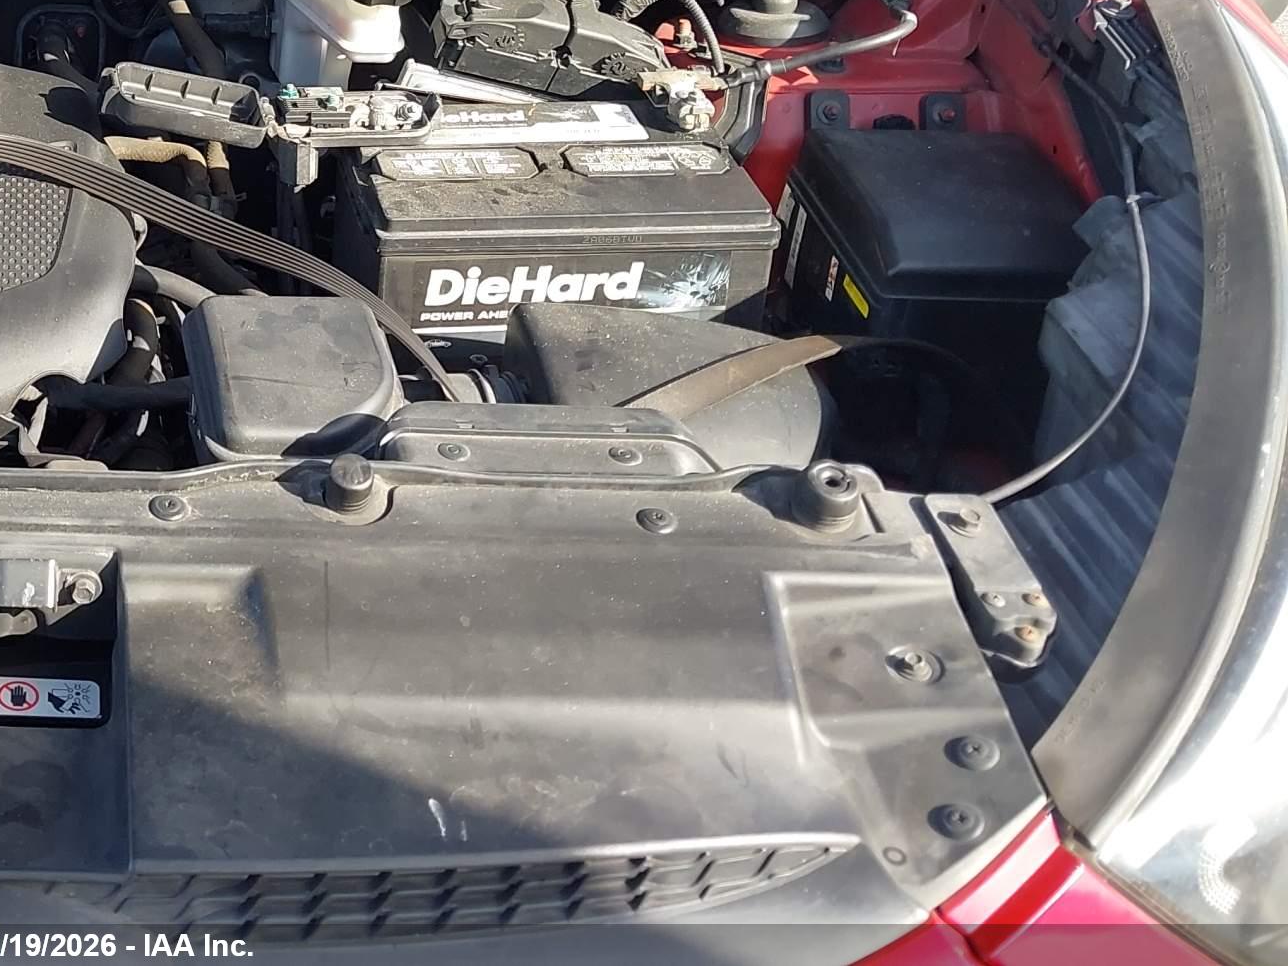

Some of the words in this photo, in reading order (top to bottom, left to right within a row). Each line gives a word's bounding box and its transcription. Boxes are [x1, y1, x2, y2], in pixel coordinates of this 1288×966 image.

[424, 261, 645, 306] DieHard
[419, 311, 474, 322] POWER
[477, 309, 509, 321] AHE
